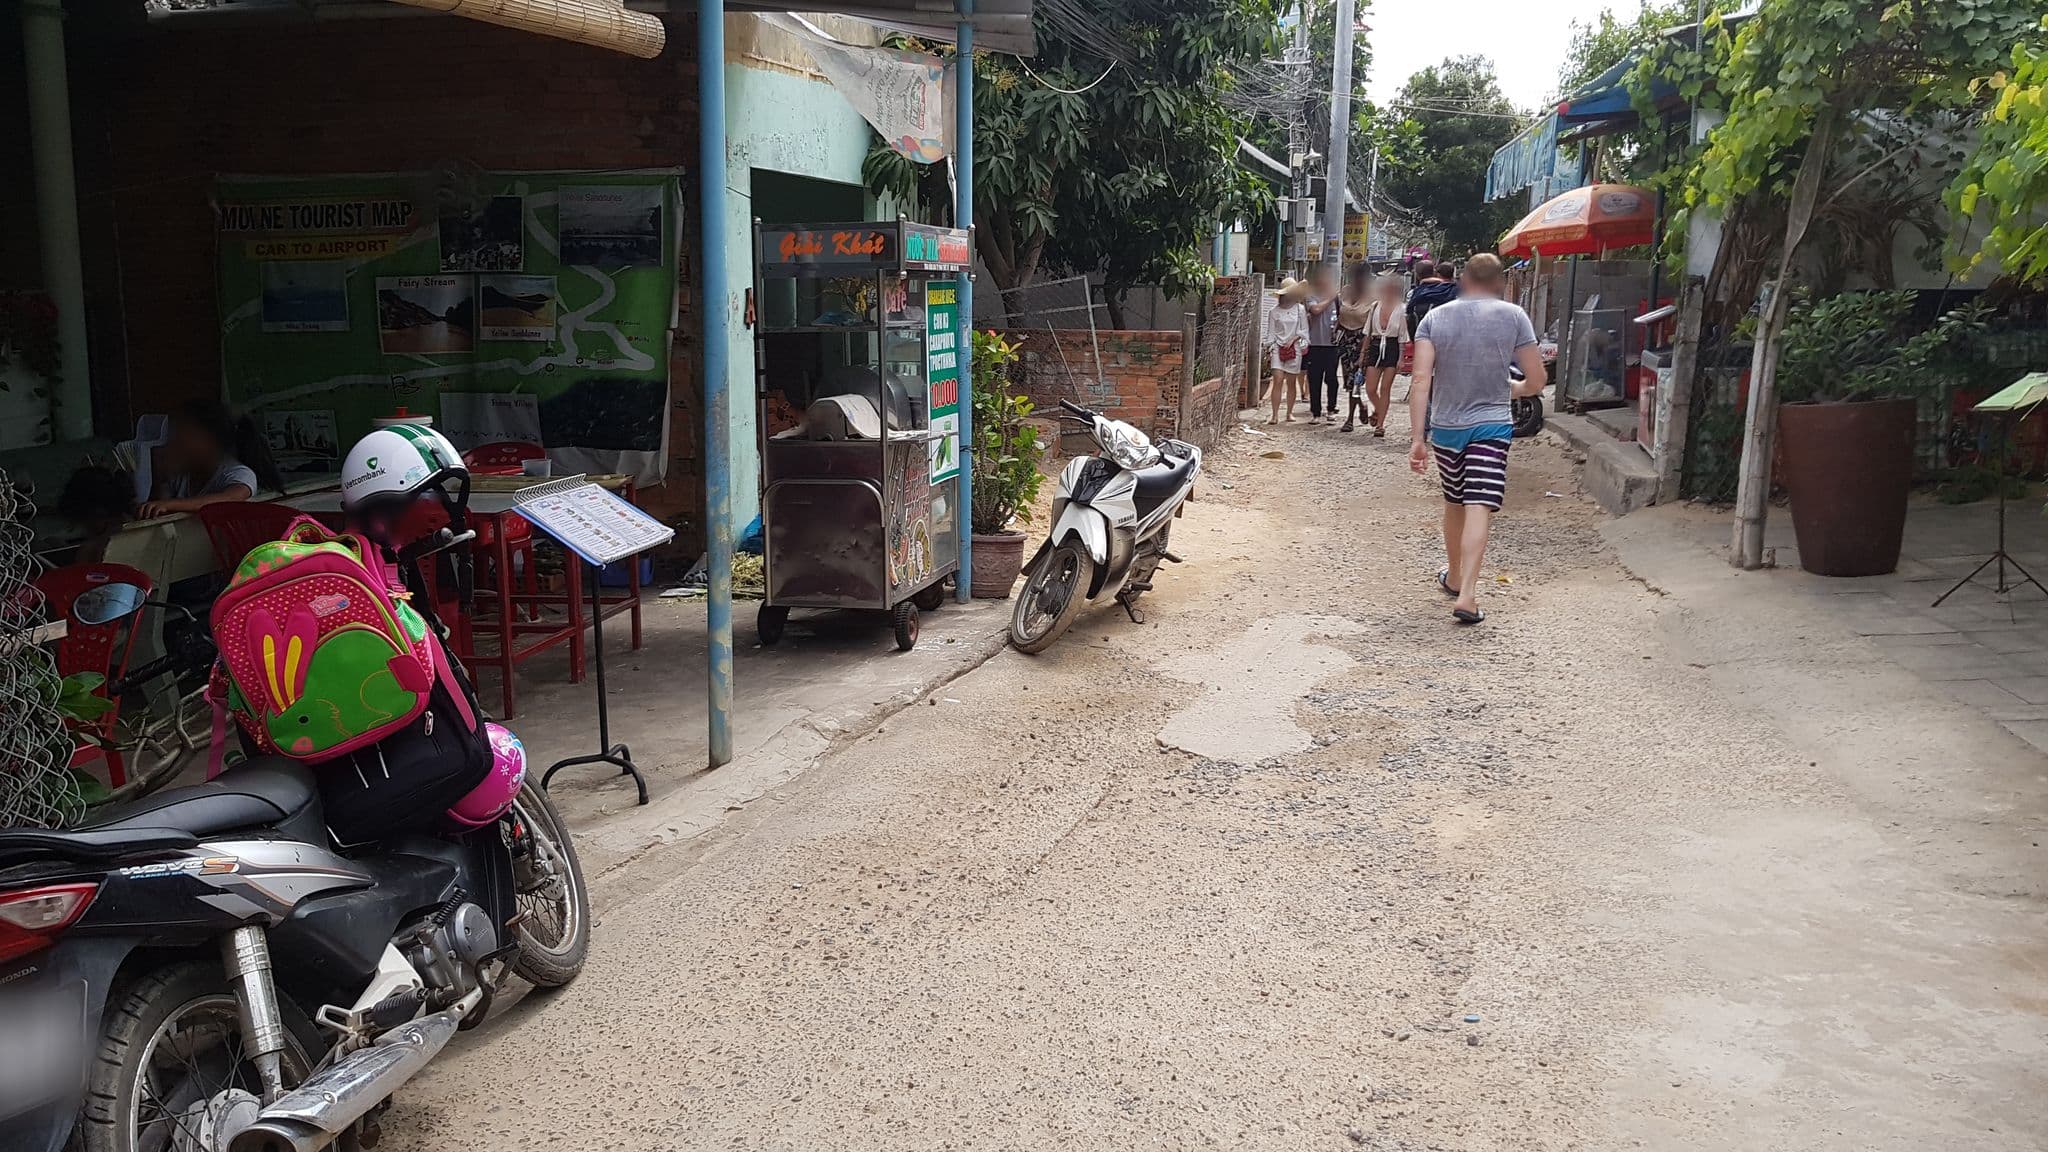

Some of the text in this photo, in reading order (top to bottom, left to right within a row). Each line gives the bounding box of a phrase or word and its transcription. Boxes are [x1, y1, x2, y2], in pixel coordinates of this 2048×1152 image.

[288, 203, 366, 229] TOURIST
[372, 201, 413, 227] MAP
[255, 240, 389, 257] CAR TO AIRPORT
[398, 277, 456, 288] Fairy Stream
[930, 378, 958, 410] 10.000
